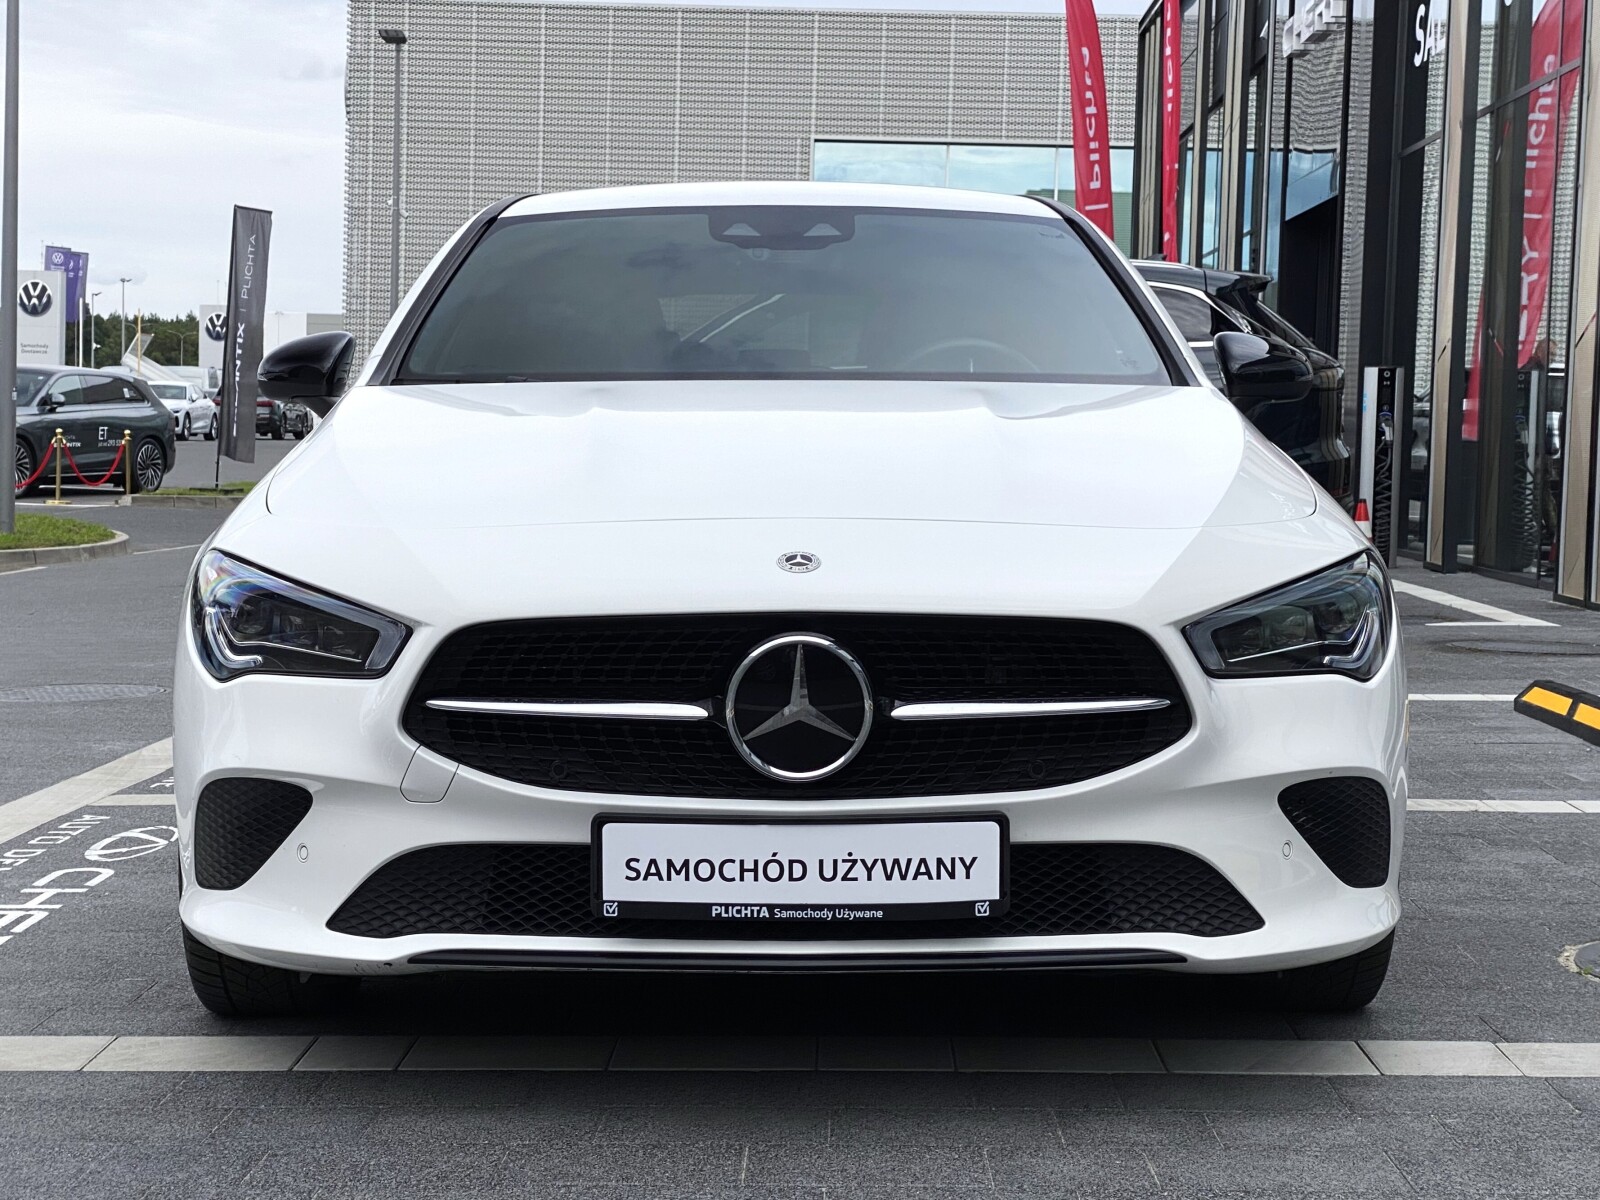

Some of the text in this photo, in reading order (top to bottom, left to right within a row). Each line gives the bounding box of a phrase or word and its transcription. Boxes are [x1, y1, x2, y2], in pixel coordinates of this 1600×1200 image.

[241, 234, 257, 300] PLICHTA
[624, 851, 979, 883] SAMOCHÓD UŻYWANY
[711, 905, 884, 921] PLICHTA Samochody Używane
